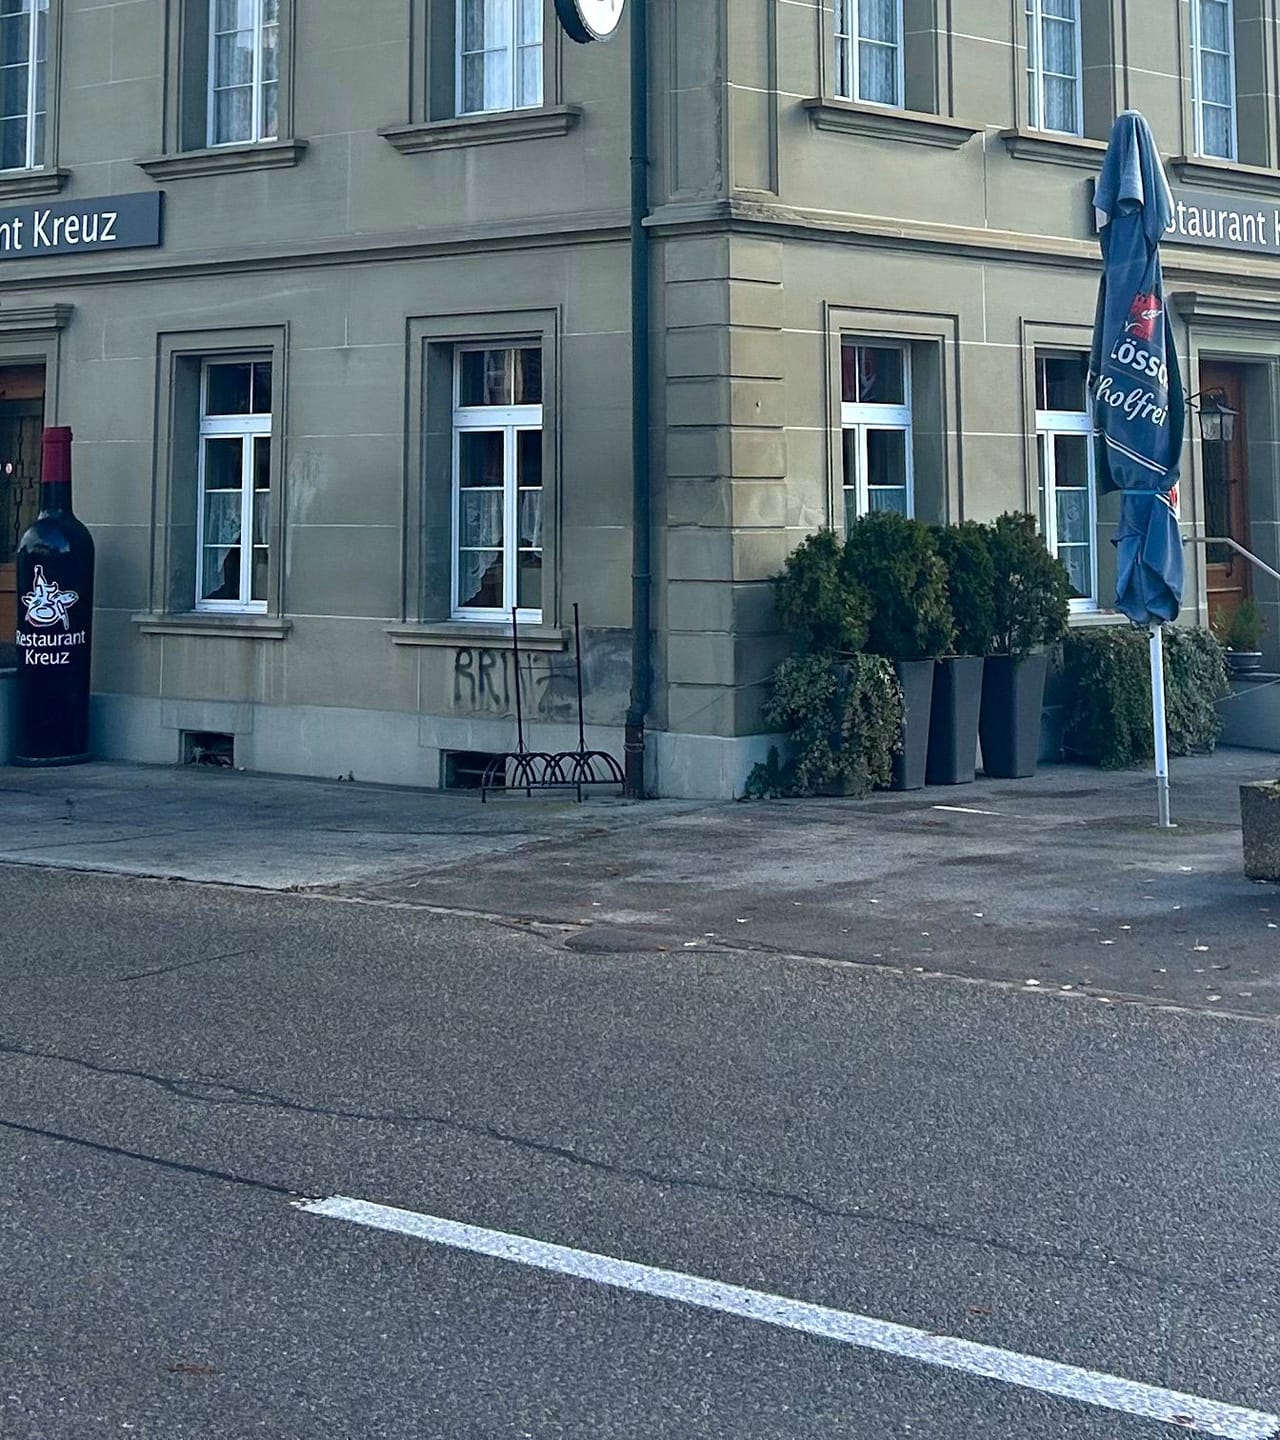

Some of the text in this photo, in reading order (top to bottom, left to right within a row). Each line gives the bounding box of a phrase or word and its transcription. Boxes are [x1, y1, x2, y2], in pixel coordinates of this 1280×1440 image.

[33, 209, 117, 247] Kreuz
[16, 629, 86, 647] Restaurant
[25, 649, 70, 665] Kreuz
